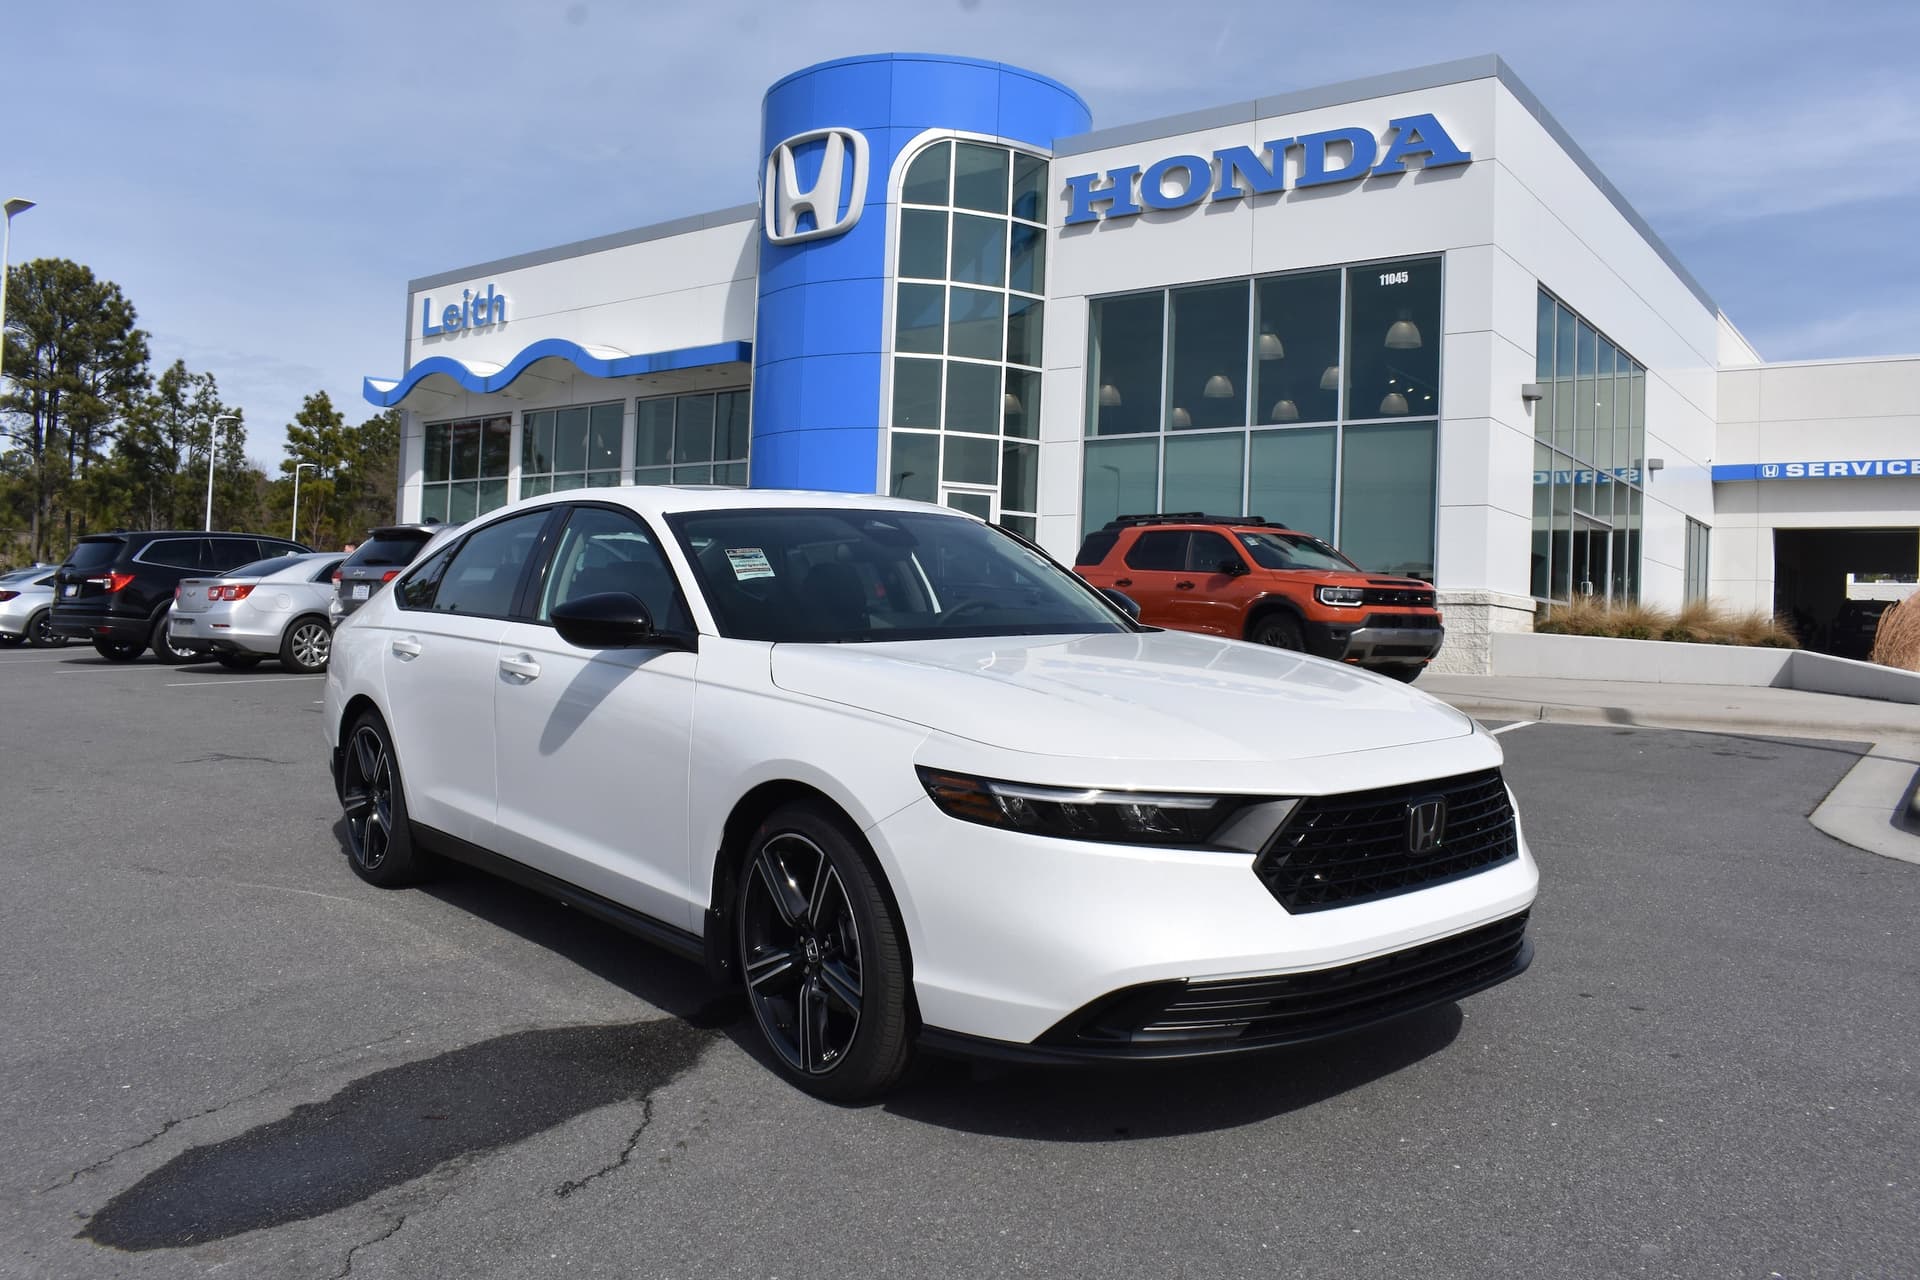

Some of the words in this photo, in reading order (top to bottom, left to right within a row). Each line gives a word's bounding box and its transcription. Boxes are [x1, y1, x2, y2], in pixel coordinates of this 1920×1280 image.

[1065, 113, 1471, 225] HONDA
[1379, 271, 1409, 286] 11045
[422, 283, 506, 337] Leith
